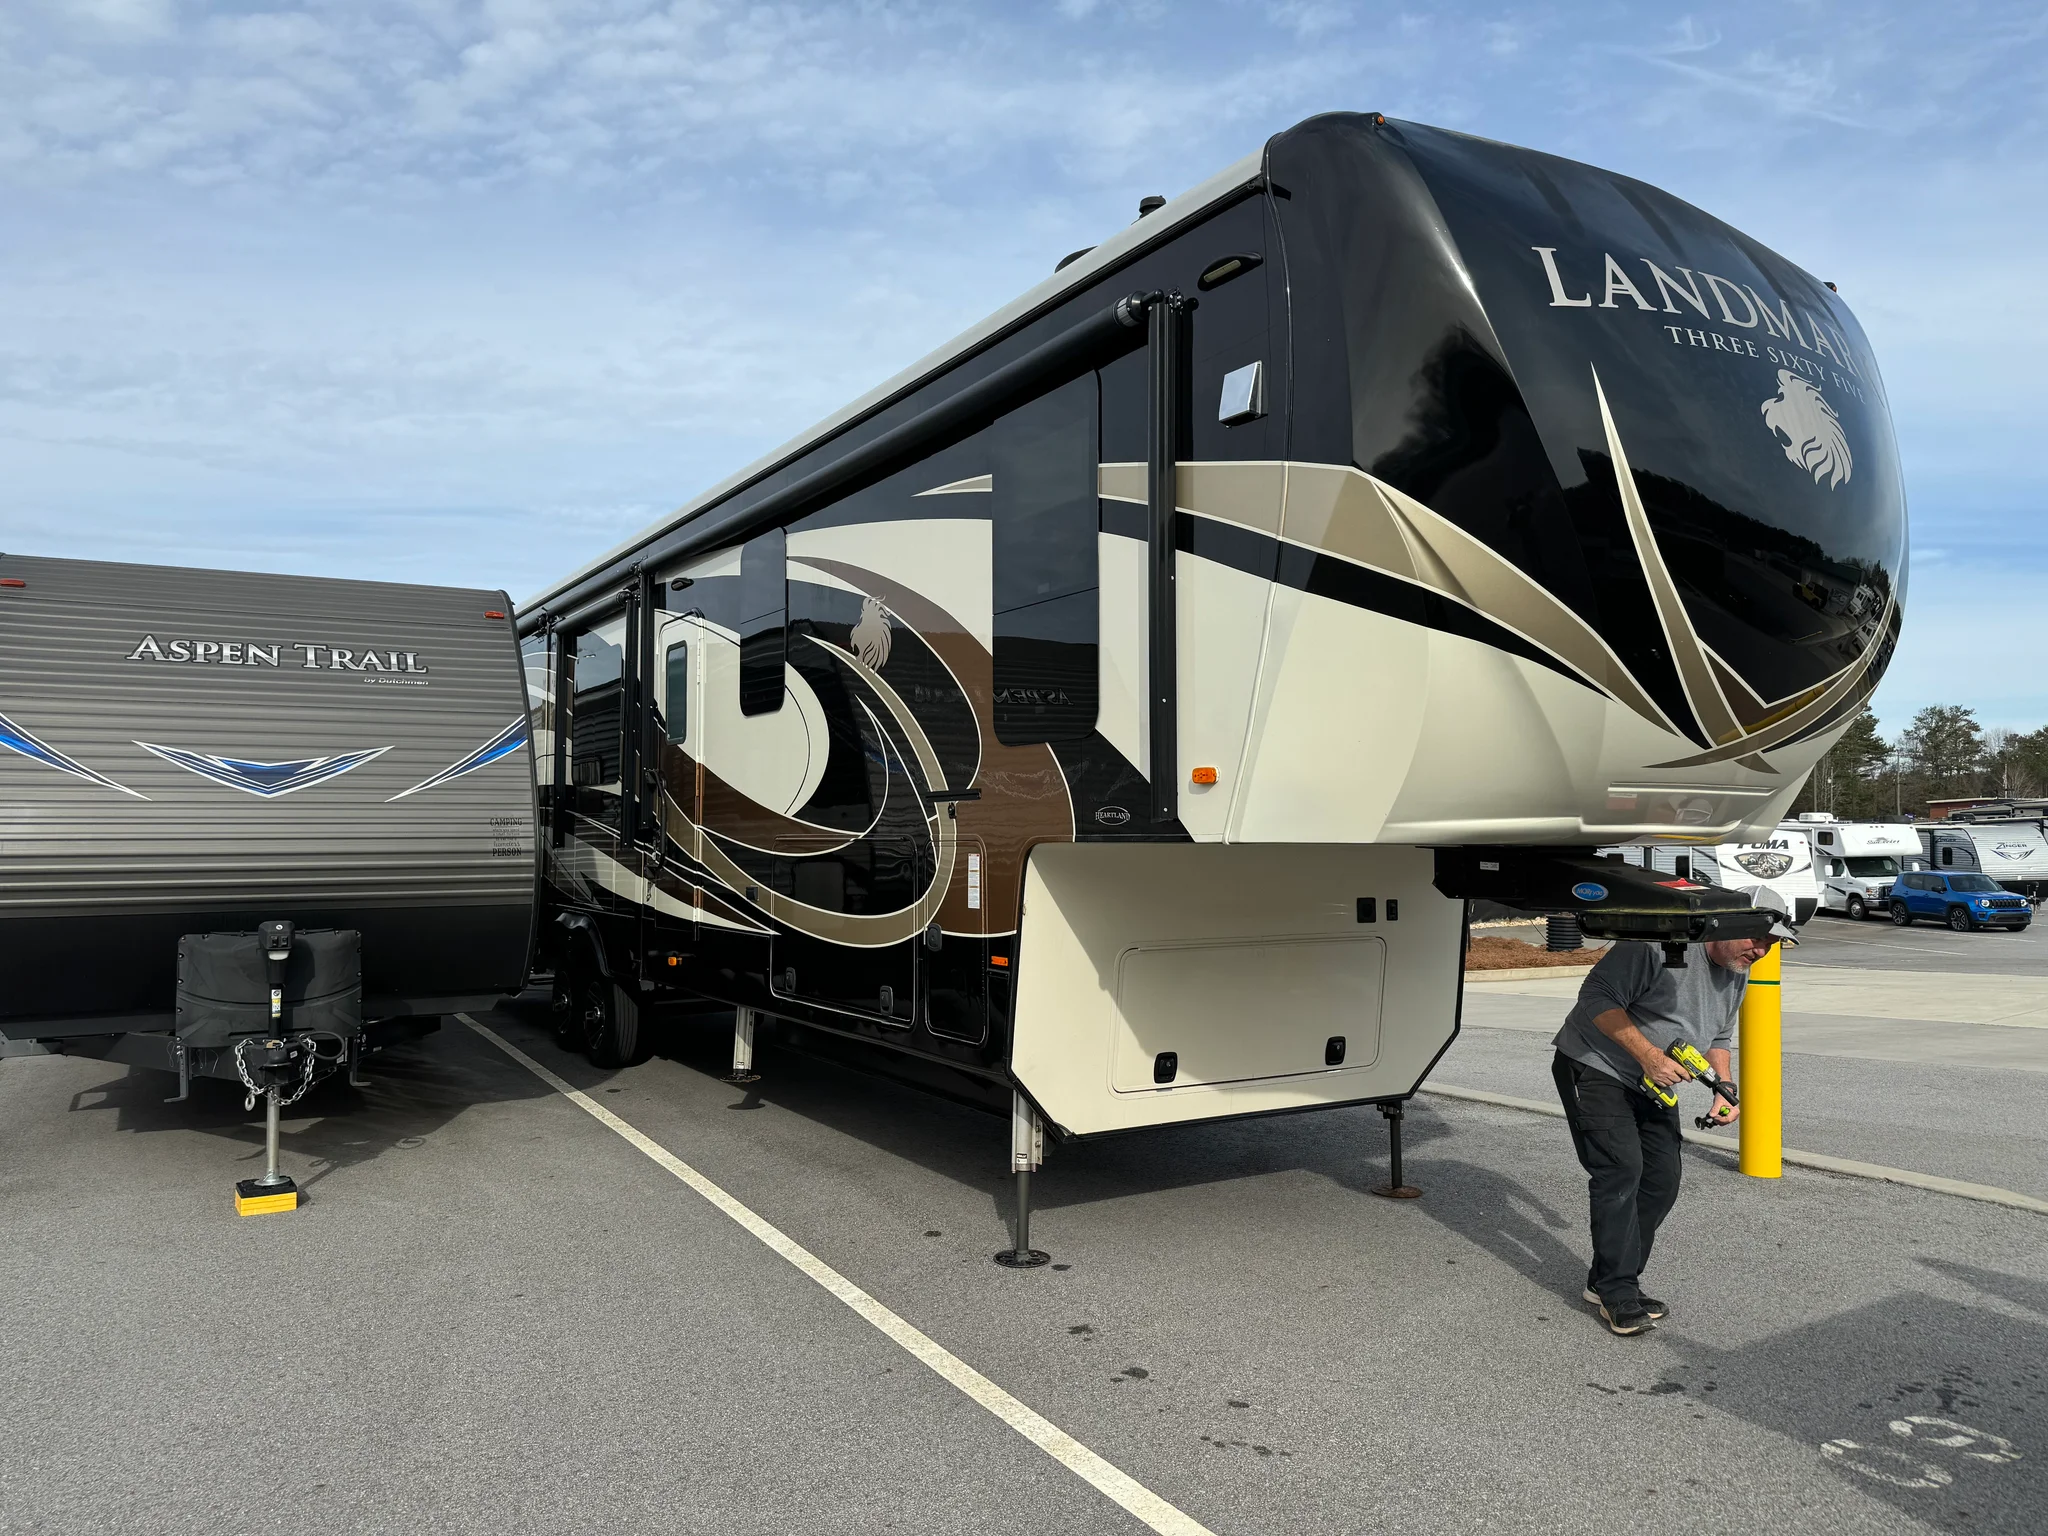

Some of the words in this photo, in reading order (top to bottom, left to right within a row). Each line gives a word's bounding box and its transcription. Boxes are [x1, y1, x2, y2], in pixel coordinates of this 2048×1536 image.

[1531, 246, 1868, 384] LANDMAR
[1664, 325, 1760, 359] THREE
[1766, 346, 1827, 382] SIXTY
[1831, 371, 1867, 405] FIVE
[125, 633, 282, 668] ASPEN
[293, 642, 429, 674] TRAIL
[363, 676, 376, 684] by
[378, 677, 429, 686] Dutchmen
[490, 818, 523, 826] CAMPING
[1095, 811, 1131, 822] HEARTLAND
[492, 847, 522, 856] PERSON
